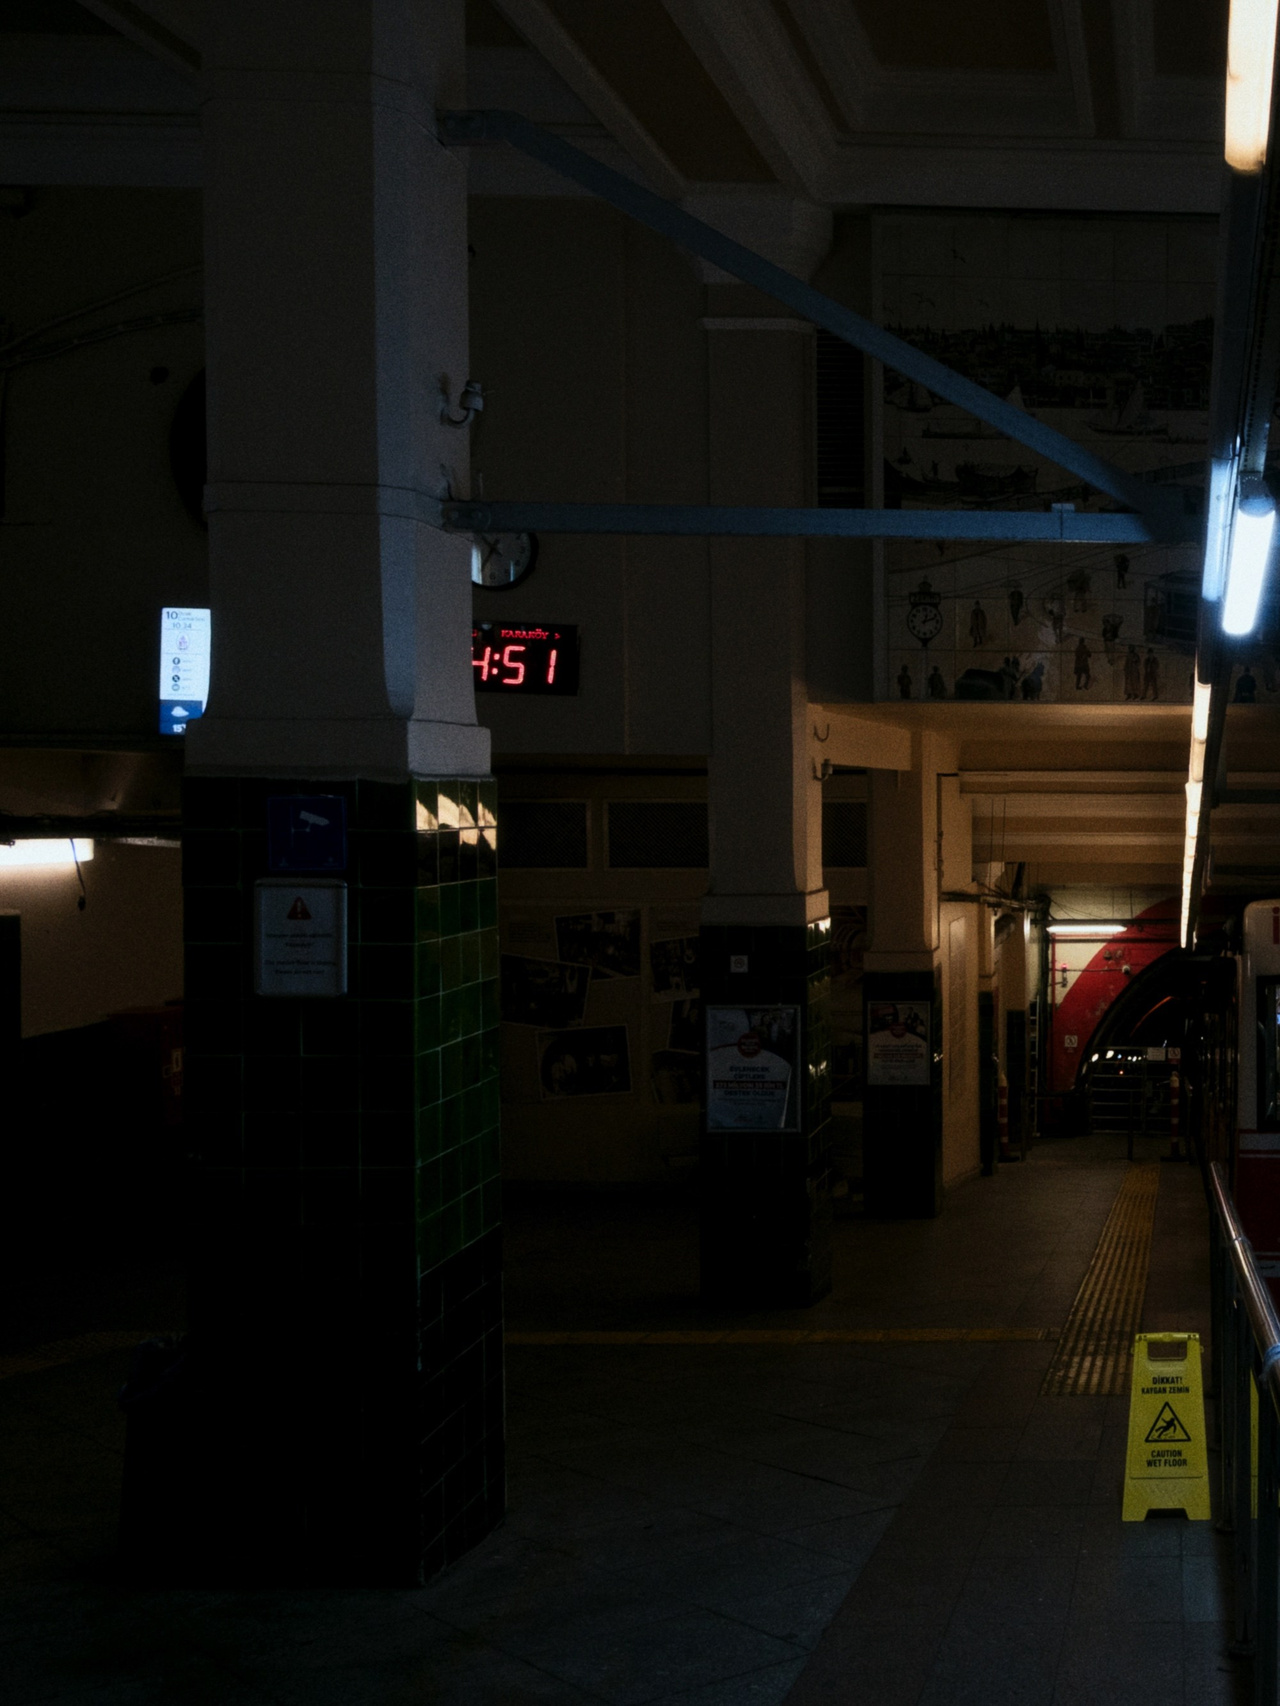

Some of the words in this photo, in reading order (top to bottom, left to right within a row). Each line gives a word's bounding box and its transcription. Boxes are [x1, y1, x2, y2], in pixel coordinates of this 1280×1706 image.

[166, 611, 179, 620] 10
[501, 628, 550, 640] KARAKÖY
[1152, 1376, 1183, 1385] DİKKAT!
[1141, 1387, 1167, 1395] KAYGAN
[1168, 1386, 1190, 1394] ZEMİN
[1151, 1449, 1182, 1457] CAUTION
[1146, 1459, 1162, 1467] WET
[1164, 1458, 1188, 1467] FLOOR
